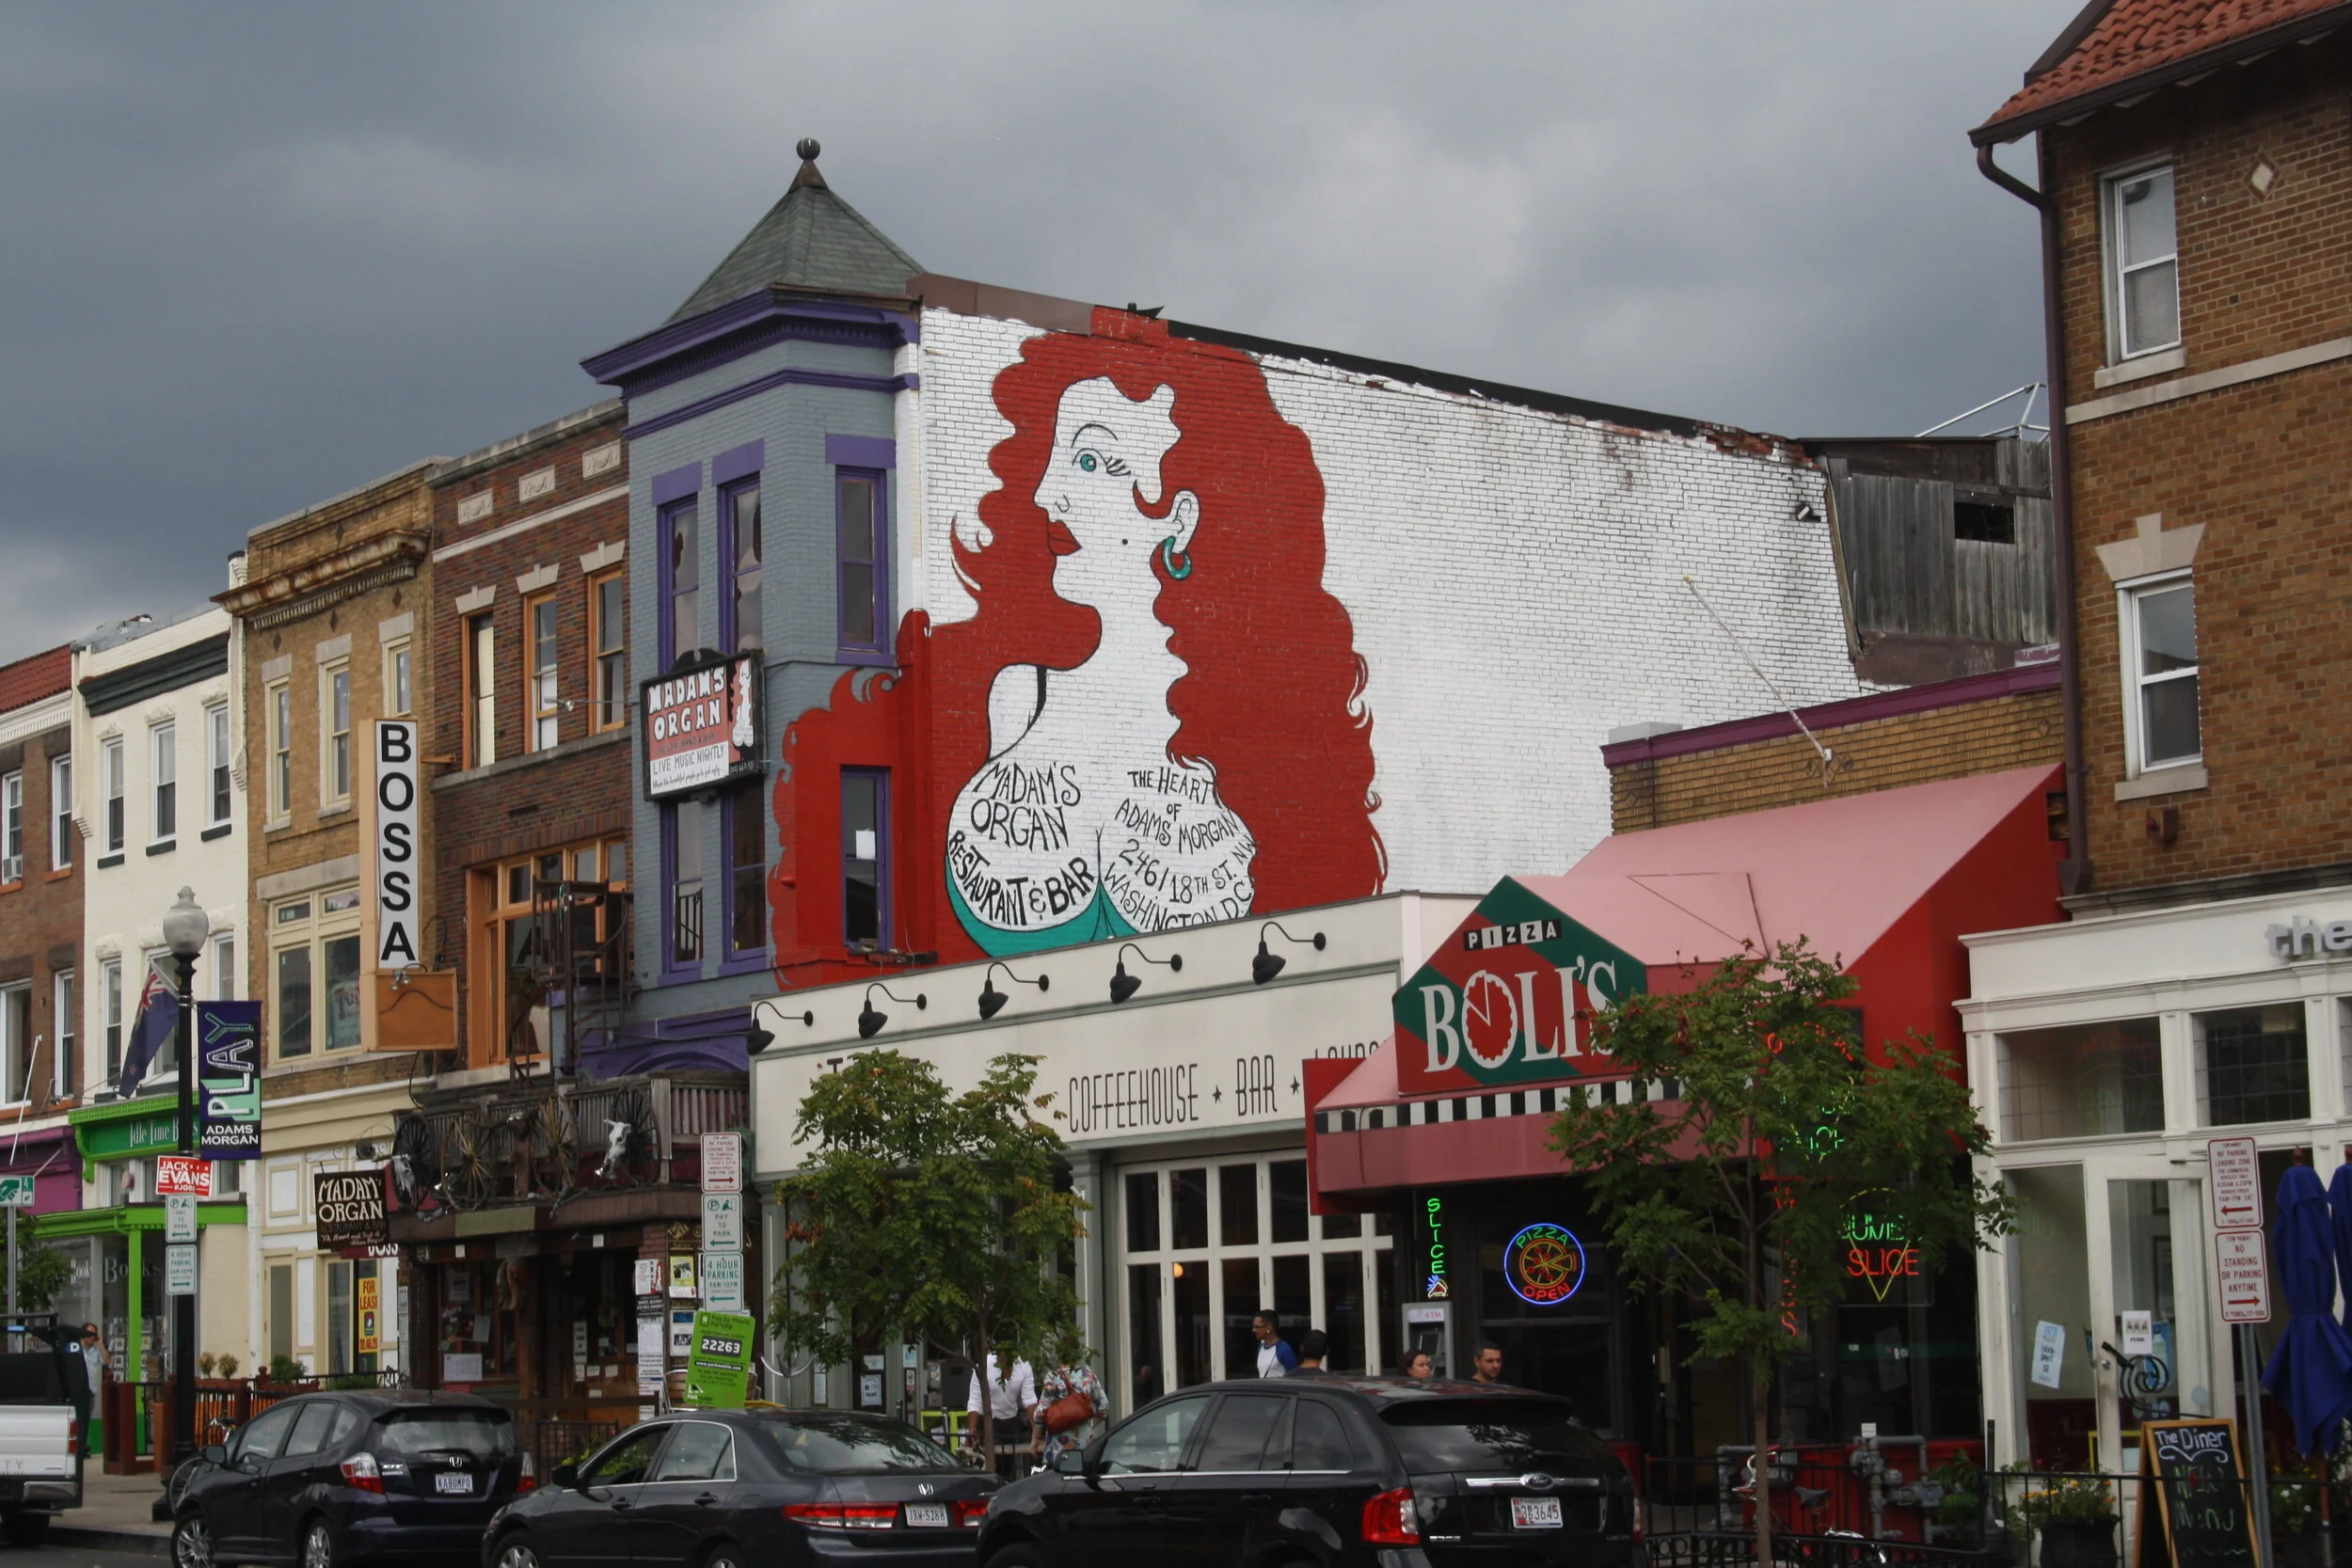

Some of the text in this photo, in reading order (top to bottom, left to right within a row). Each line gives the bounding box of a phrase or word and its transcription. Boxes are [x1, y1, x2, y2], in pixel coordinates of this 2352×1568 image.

[648, 665, 725, 715] MADAM'S
[654, 699, 721, 741] ORGAN
[653, 743, 725, 775] LIVE MUSIC NIGHTLY
[972, 761, 1081, 806] MADAM'S
[1127, 767, 1215, 804] THE HEART
[971, 799, 1069, 852] ORGAN
[1167, 802, 1182, 822] OF
[1114, 798, 1240, 855] ADAMS MORGAN
[378, 723, 416, 961] BOSSA
[948, 830, 1028, 927] RESTAURANT
[1044, 857, 1095, 915] BAR
[1169, 875, 1209, 904] 18TH
[1212, 860, 1237, 890] ST.
[1232, 834, 1256, 863] NW
[1468, 921, 1557, 949] PIZZA
[2265, 915, 2352, 958] the
[1418, 955, 1617, 1073] BOLI'S
[204, 1012, 254, 1117] PLAY
[1070, 1054, 1278, 1133] COFFEEHOUSE BAR
[150, 1118, 169, 1145] Time
[201, 1134, 259, 1145] MORGAN
[206, 1124, 253, 1134] ADAMS
[158, 1170, 210, 1186] EVANS
[160, 1161, 188, 1171] JACK
[319, 1200, 383, 1223] ORGAN
[1427, 1197, 1445, 1275] SLICE
[1516, 1227, 1568, 1248] PIZZA
[1840, 1213, 1923, 1242] JUMB
[1847, 1248, 1920, 1276] SLICE
[2224, 1257, 2258, 1267] STANDING
[2234, 1244, 2245, 1253] NO
[104, 1257, 162, 1284] Boks
[707, 1260, 739, 1269] 4 HOUR
[707, 1270, 739, 1279] PARKING
[2221, 1270, 2263, 1279] OR PARKING
[363, 1280, 375, 1294] FOR
[1523, 1283, 1571, 1301] OPEN
[2228, 1282, 2258, 1292] ANYTIME
[1424, 1310, 1441, 1319] ATM
[702, 1338, 740, 1354] 22263
[2154, 1428, 2227, 1449] The Diner
